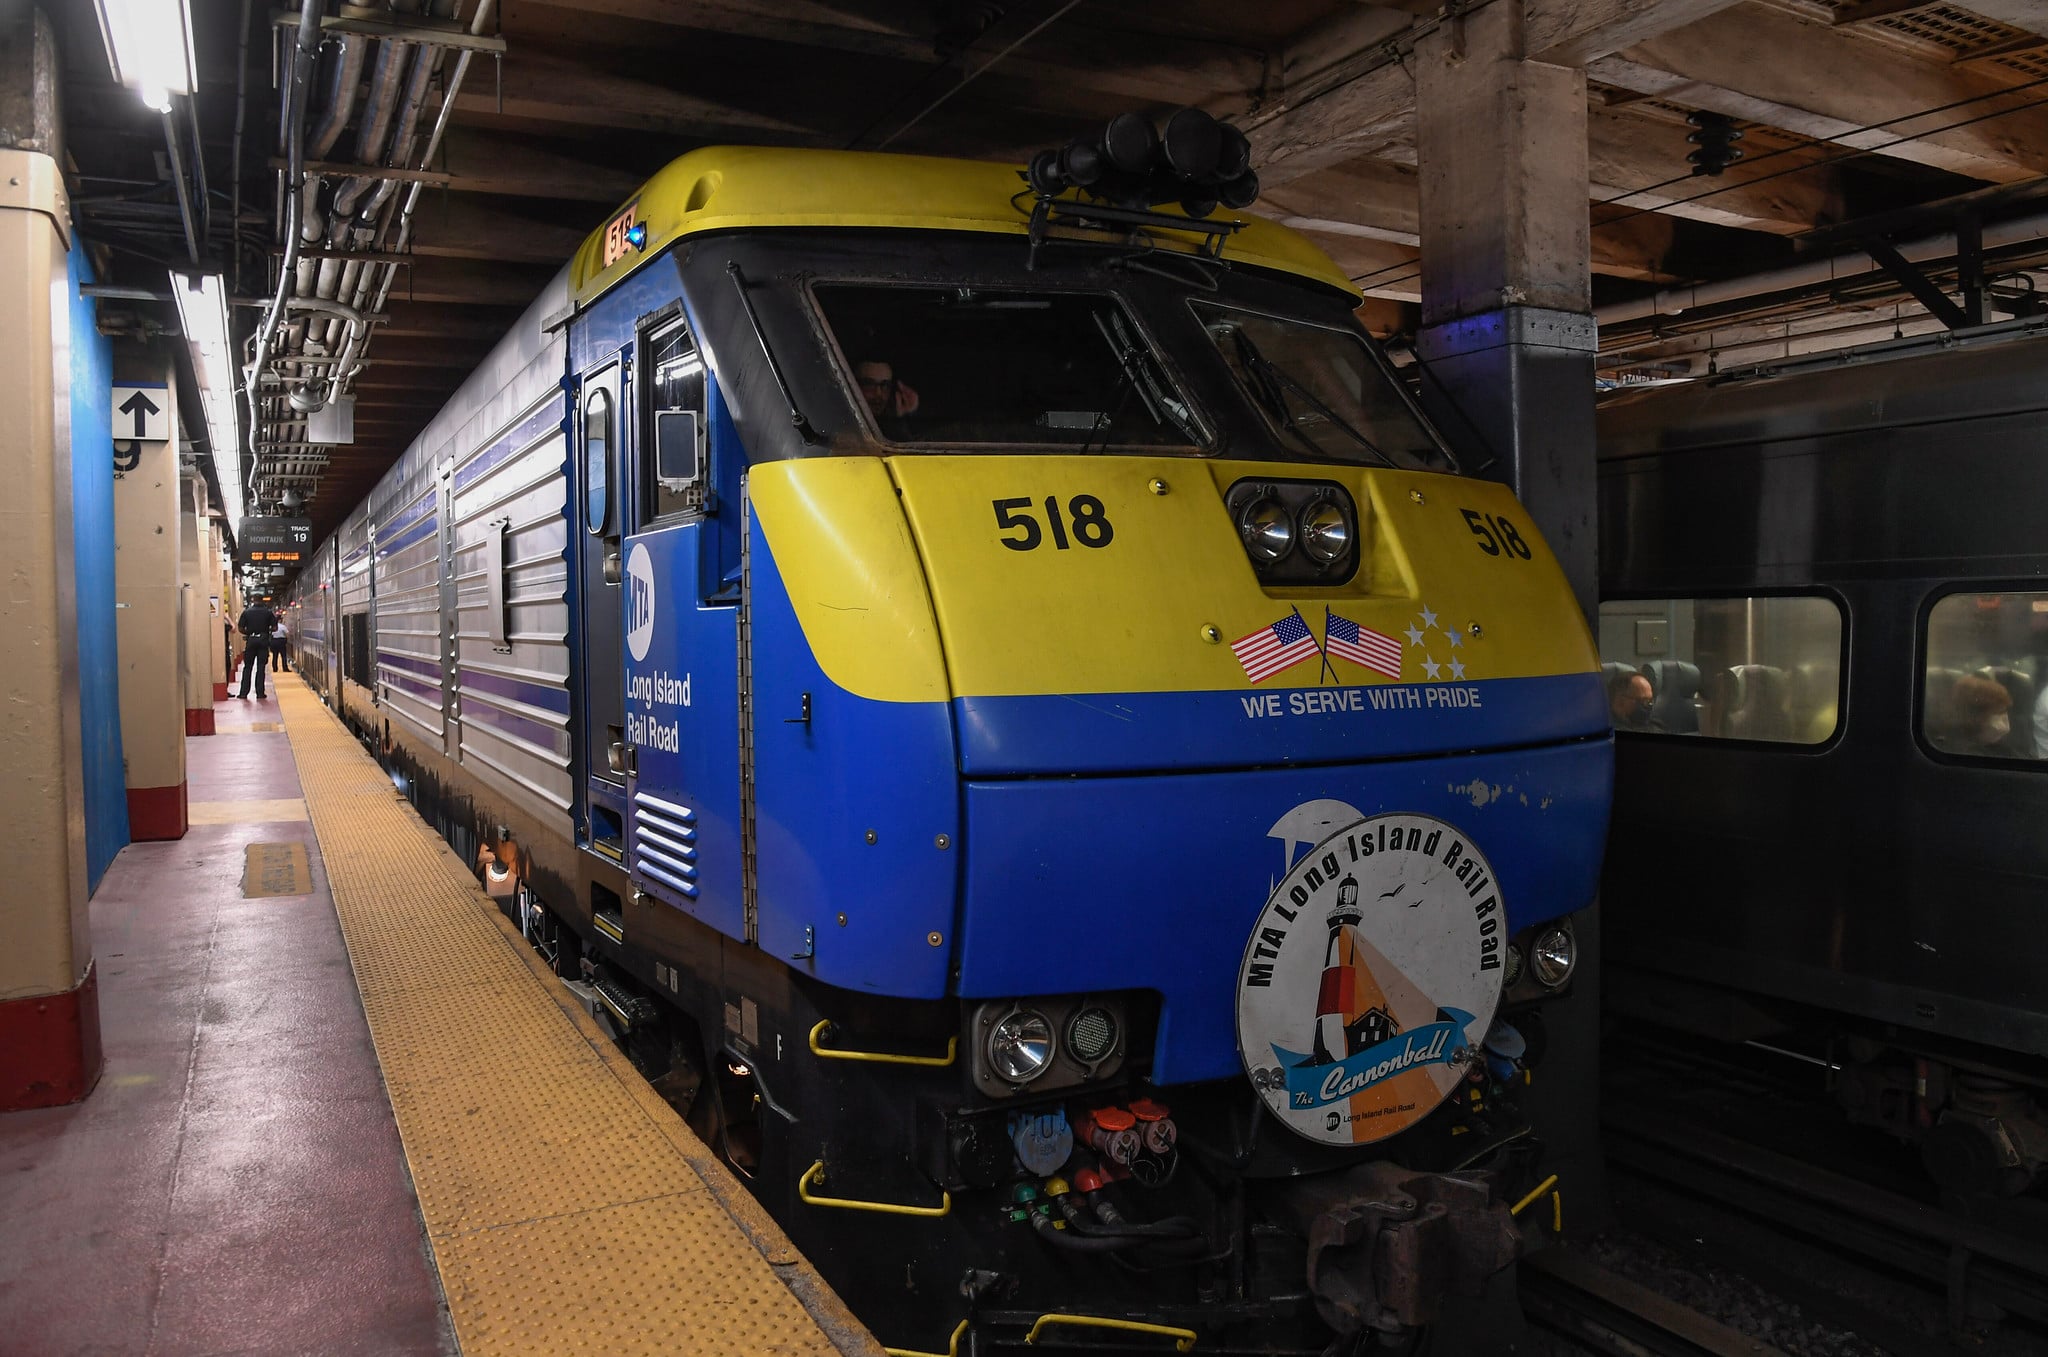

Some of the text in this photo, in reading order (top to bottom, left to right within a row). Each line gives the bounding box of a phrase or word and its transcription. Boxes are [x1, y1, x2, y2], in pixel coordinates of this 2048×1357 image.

[249, 535, 284, 544] MONTAUK
[293, 532, 307, 543] 19
[992, 494, 1114, 551] 518
[1459, 507, 1532, 561] 518
[626, 667, 691, 709] Long Island
[1240, 687, 1483, 719] WE SERVE WITH PRIDE
[627, 711, 680, 754] Rail Road
[1246, 824, 1502, 988] MTA Long Island Rail Road
[776, 1033, 783, 1061] F
[1295, 1029, 1452, 1105] The Cannonball
[1343, 1114, 1361, 1123] Long
[1362, 1109, 1383, 1119] Island
[1383, 1106, 1397, 1115] Rail
[1398, 1102, 1416, 1112] Road
